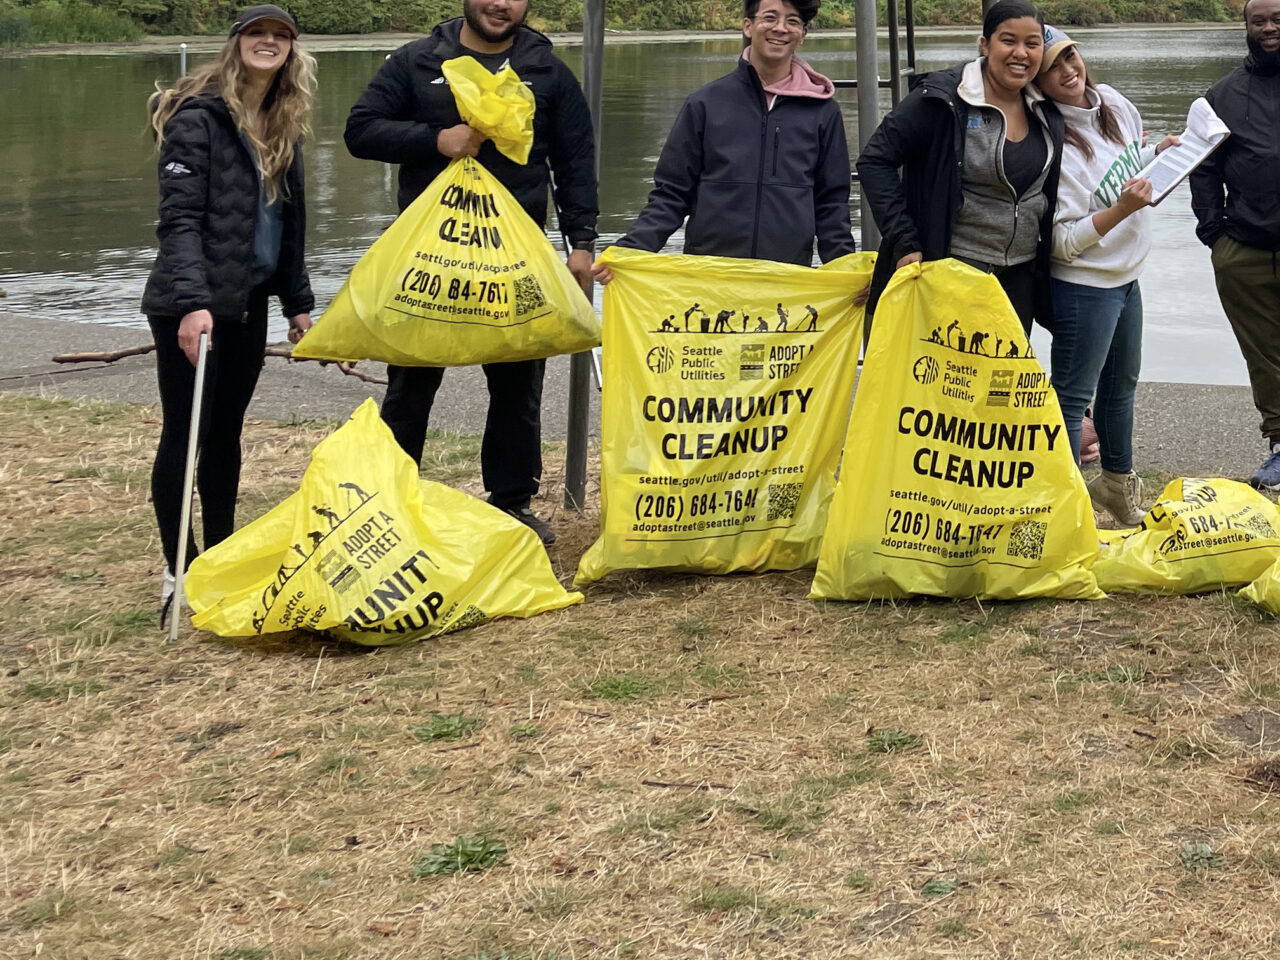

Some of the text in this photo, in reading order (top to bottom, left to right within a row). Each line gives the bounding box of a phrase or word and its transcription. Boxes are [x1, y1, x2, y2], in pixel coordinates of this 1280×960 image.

[1094, 141, 1142, 208] VERM
[681, 358, 714, 368] Public
[682, 346, 723, 356] Seattle
[769, 344, 806, 362] ADOPT
[681, 370, 725, 380] Utilities
[944, 373, 972, 388] Public
[946, 360, 978, 376] Seattle
[642, 387, 814, 424] COMMUNITY
[1014, 391, 1048, 408] STREET
[662, 425, 788, 460] CLEANUP
[898, 406, 1062, 452] COMMUNITY
[913, 448, 1034, 488] CLEANUP
[636, 494, 684, 522] (206)
[890, 490, 1052, 516] seattle.gov/util/adopt-a-street
[342, 510, 394, 556] ADOPT A
[885, 507, 1004, 546] (206) 684-7647
[356, 528, 402, 570] STREET
[279, 591, 304, 626] Seattle
